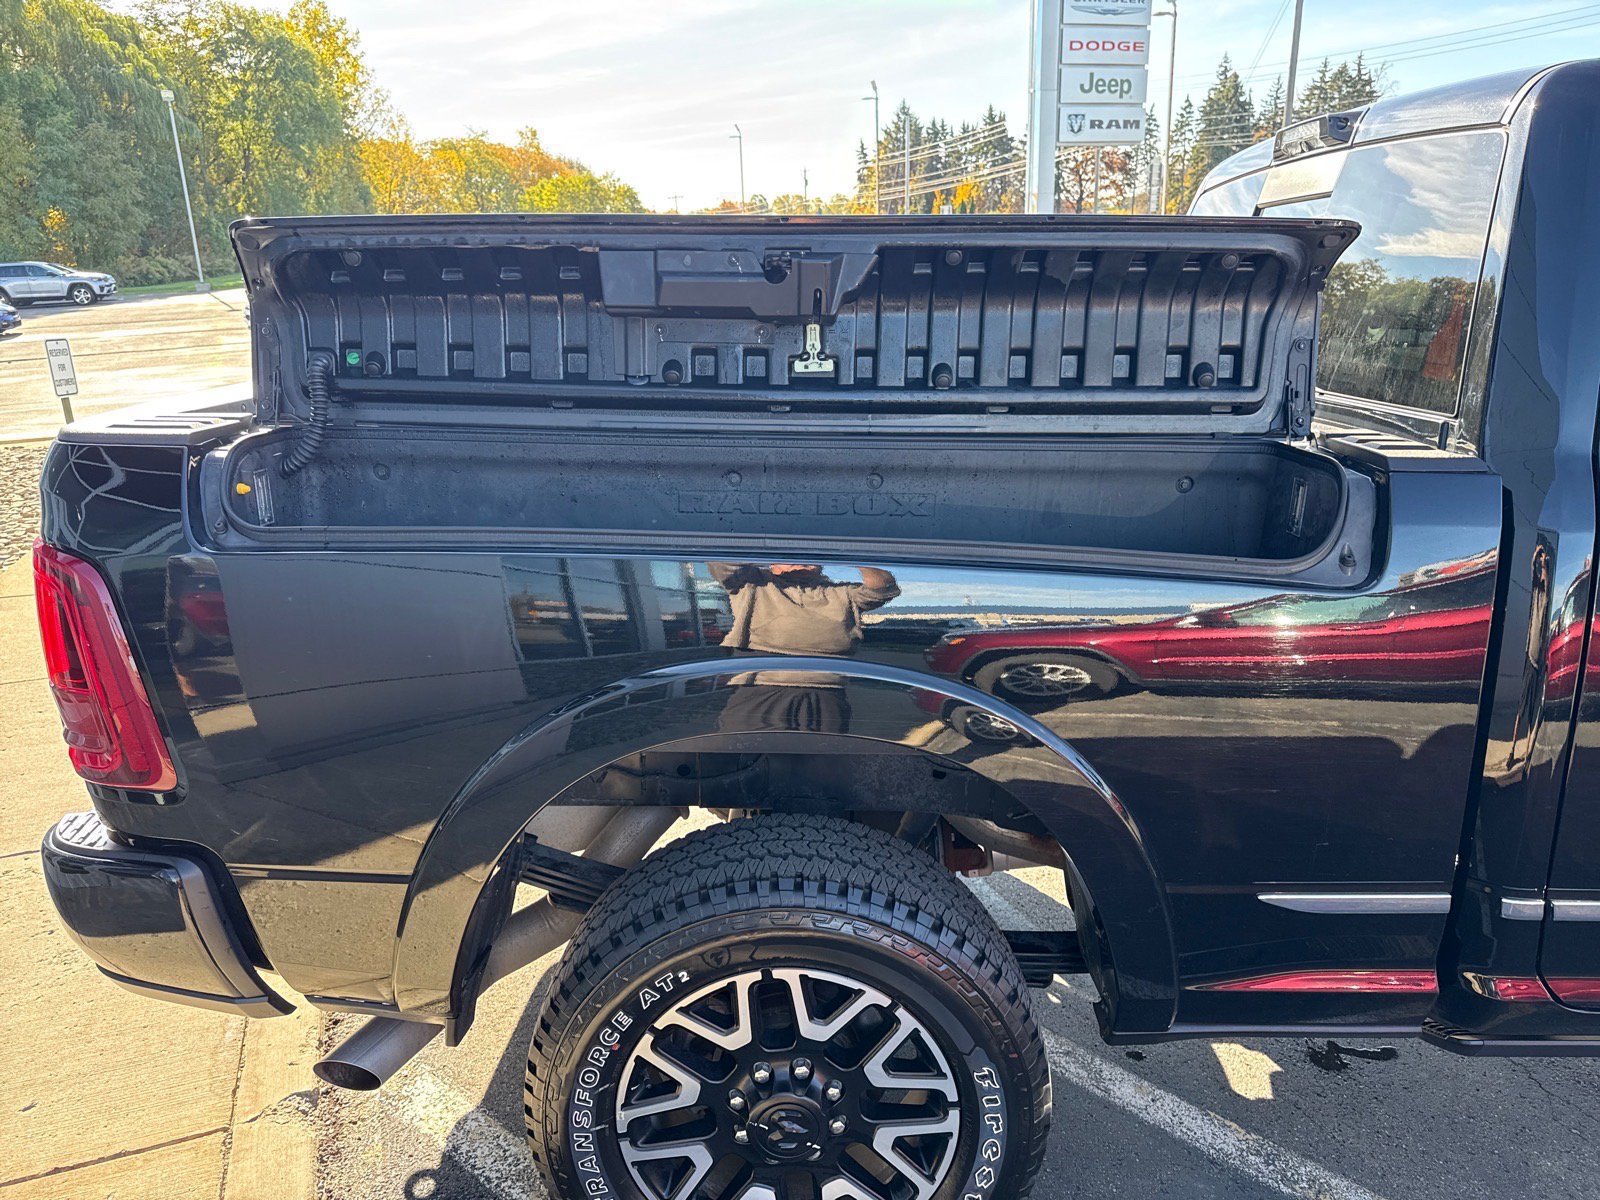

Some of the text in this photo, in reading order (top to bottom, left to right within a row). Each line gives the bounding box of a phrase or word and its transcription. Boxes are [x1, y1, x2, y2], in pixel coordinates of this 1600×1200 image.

[1069, 40, 1145, 52] DODGE
[1079, 72, 1132, 99] Jeep
[1089, 119, 1141, 130] RAM
[57, 363, 66, 372] FOR
[573, 1011, 633, 1200] RANSFORCE
